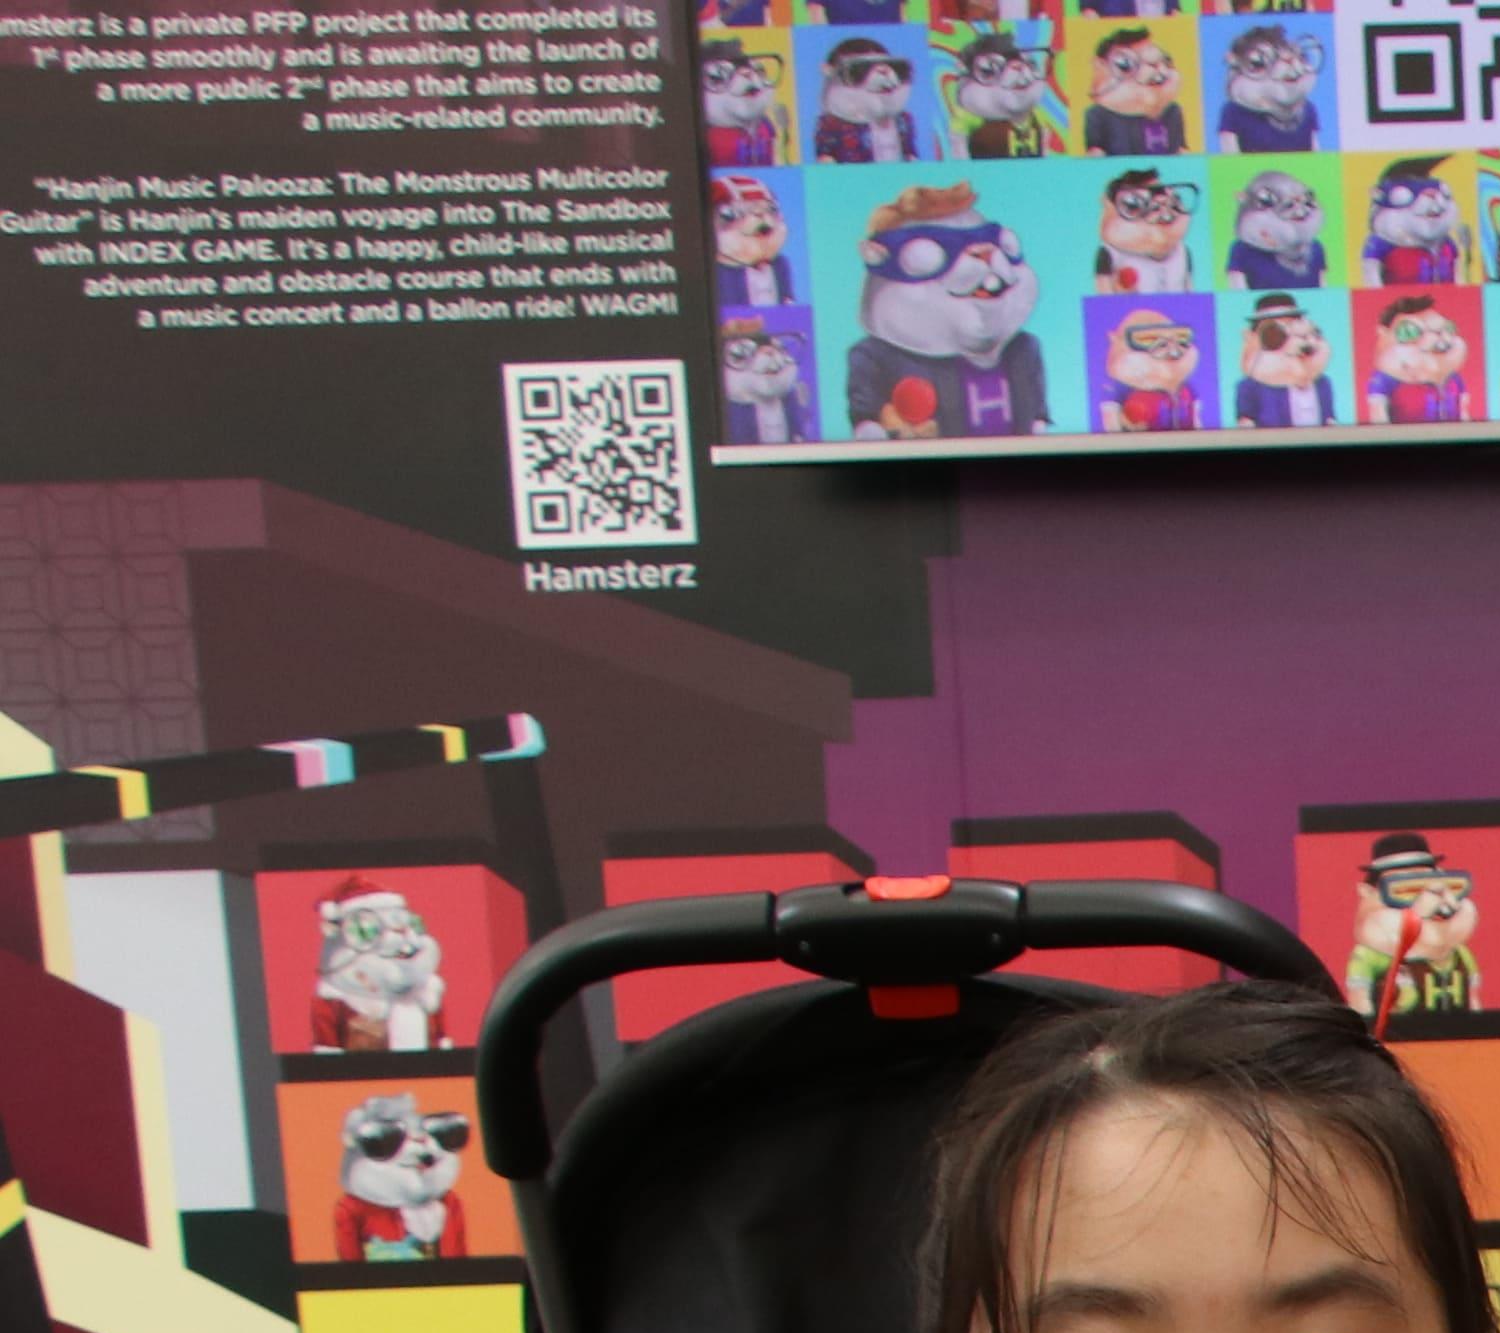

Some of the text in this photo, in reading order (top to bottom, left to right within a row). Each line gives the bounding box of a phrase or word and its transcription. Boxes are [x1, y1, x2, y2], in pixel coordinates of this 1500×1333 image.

[100, 12, 124, 36] is
[128, 17, 147, 36] a
[151, 11, 248, 39] private
[252, 11, 307, 34] PFP
[313, 10, 409, 37] project
[415, 10, 471, 31] that
[475, 6, 617, 33] completed
[624, 5, 657, 28] its
[64, 45, 147, 73] phase
[151, 44, 276, 72] smoothly
[282, 44, 334, 67] and
[340, 42, 361, 65] is
[368, 42, 482, 67] awaiting
[485, 39, 531, 62] the
[536, 38, 625, 62] launch
[630, 36, 658, 60] of
[97, 72, 663, 104] a more public 2nd phase that aims to create
[302, 102, 665, 132] a music-related community.
[33, 166, 671, 203] "Hanjin Music Palooza: The Monstrous Multicolor
[0, 197, 672, 235] Guitar" is Hanjin's maiden voyage into The Sandbox
[34, 228, 675, 266] with INDEX GAME. It's a happy, child-like musical
[83, 260, 677, 298] adventure and obstacle course that ends with
[137, 292, 679, 329] a music concert and a ballon ride! WAGMI
[967, 378, 1011, 426] H
[524, 558, 697, 594] Hamsterz
[1425, 970, 1463, 1009] H
